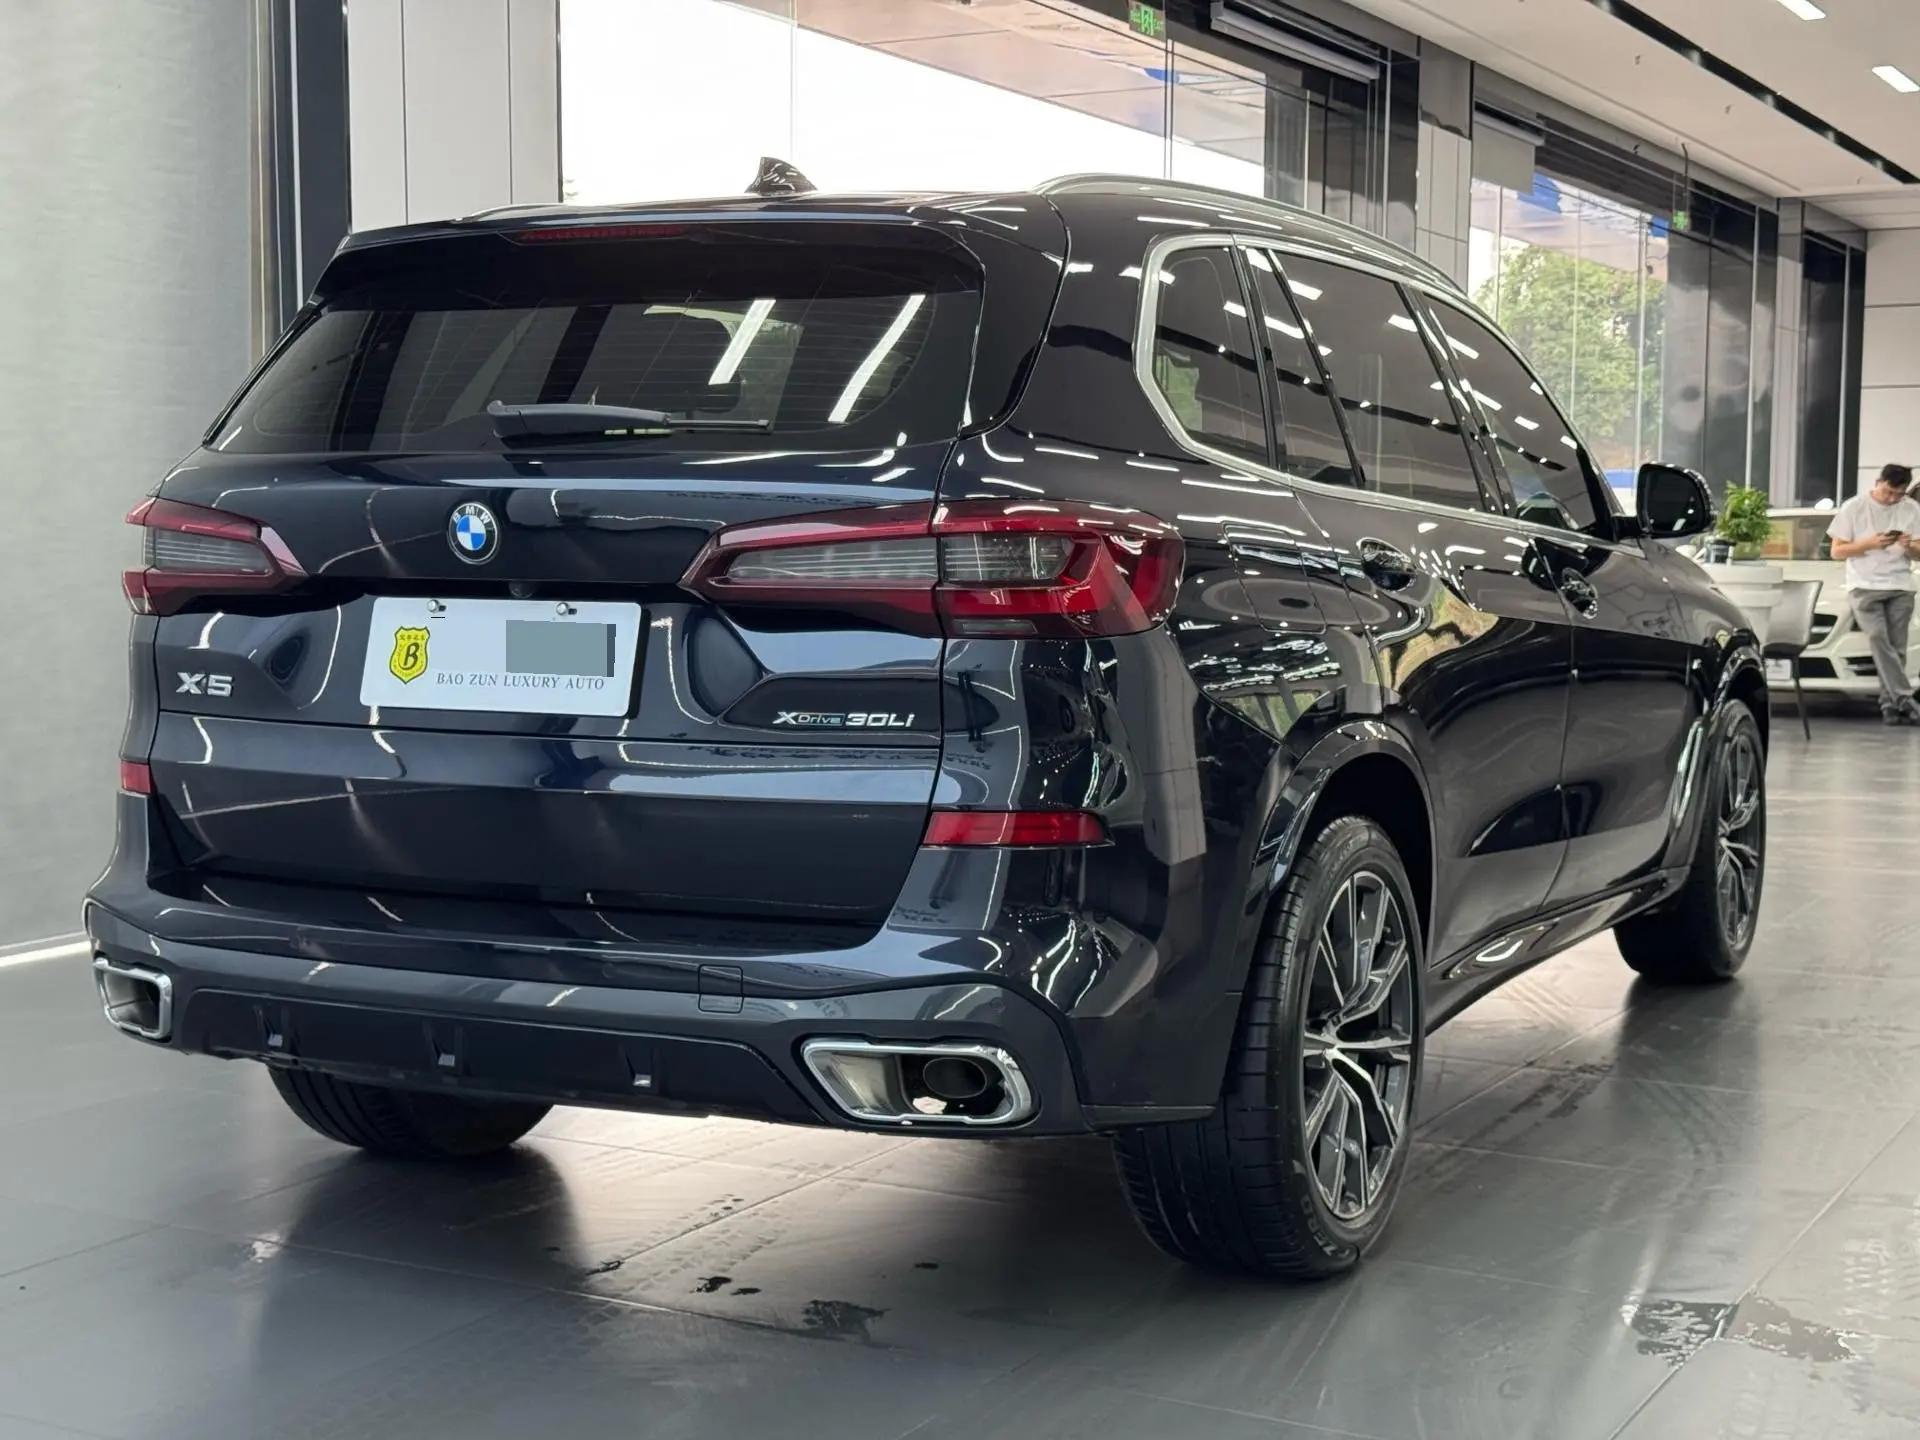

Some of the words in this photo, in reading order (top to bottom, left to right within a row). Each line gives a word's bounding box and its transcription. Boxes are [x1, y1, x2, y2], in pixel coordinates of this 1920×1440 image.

[453, 505, 491, 524] BMW
[175, 671, 232, 697] X5
[436, 672, 464, 685] BAO
[469, 673, 498, 687] ZUN
[503, 675, 560, 689] LUXURY
[565, 676, 604, 690] AUTO
